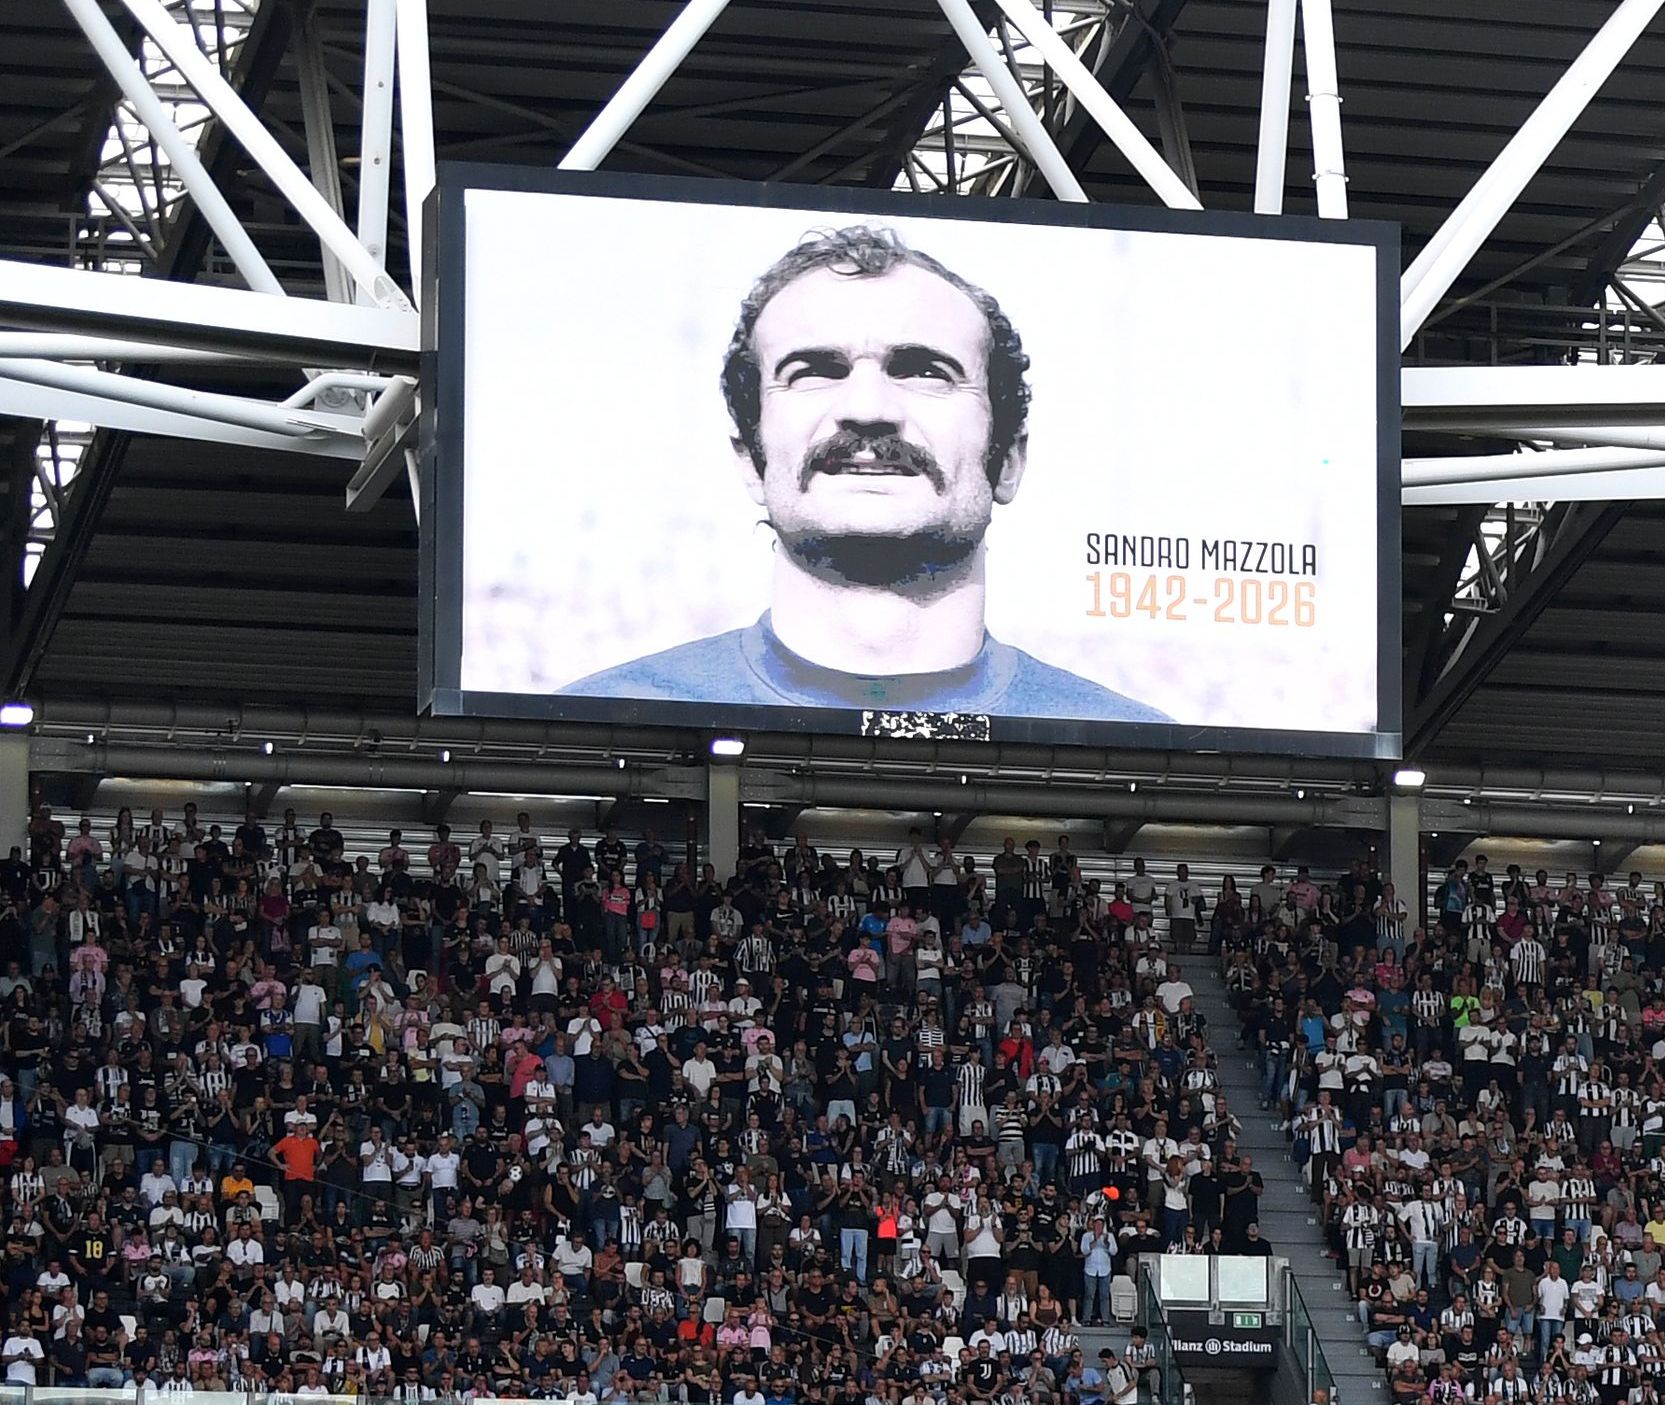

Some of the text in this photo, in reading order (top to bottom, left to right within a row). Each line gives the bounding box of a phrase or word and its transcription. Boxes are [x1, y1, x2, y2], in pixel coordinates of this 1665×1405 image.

[1087, 533, 1316, 576] SANDRO MAZZOLA
[1086, 571, 1316, 627] 1942-2026
[85, 1240, 104, 1259] 18
[1171, 1339, 1272, 1353] llianz Stadium
